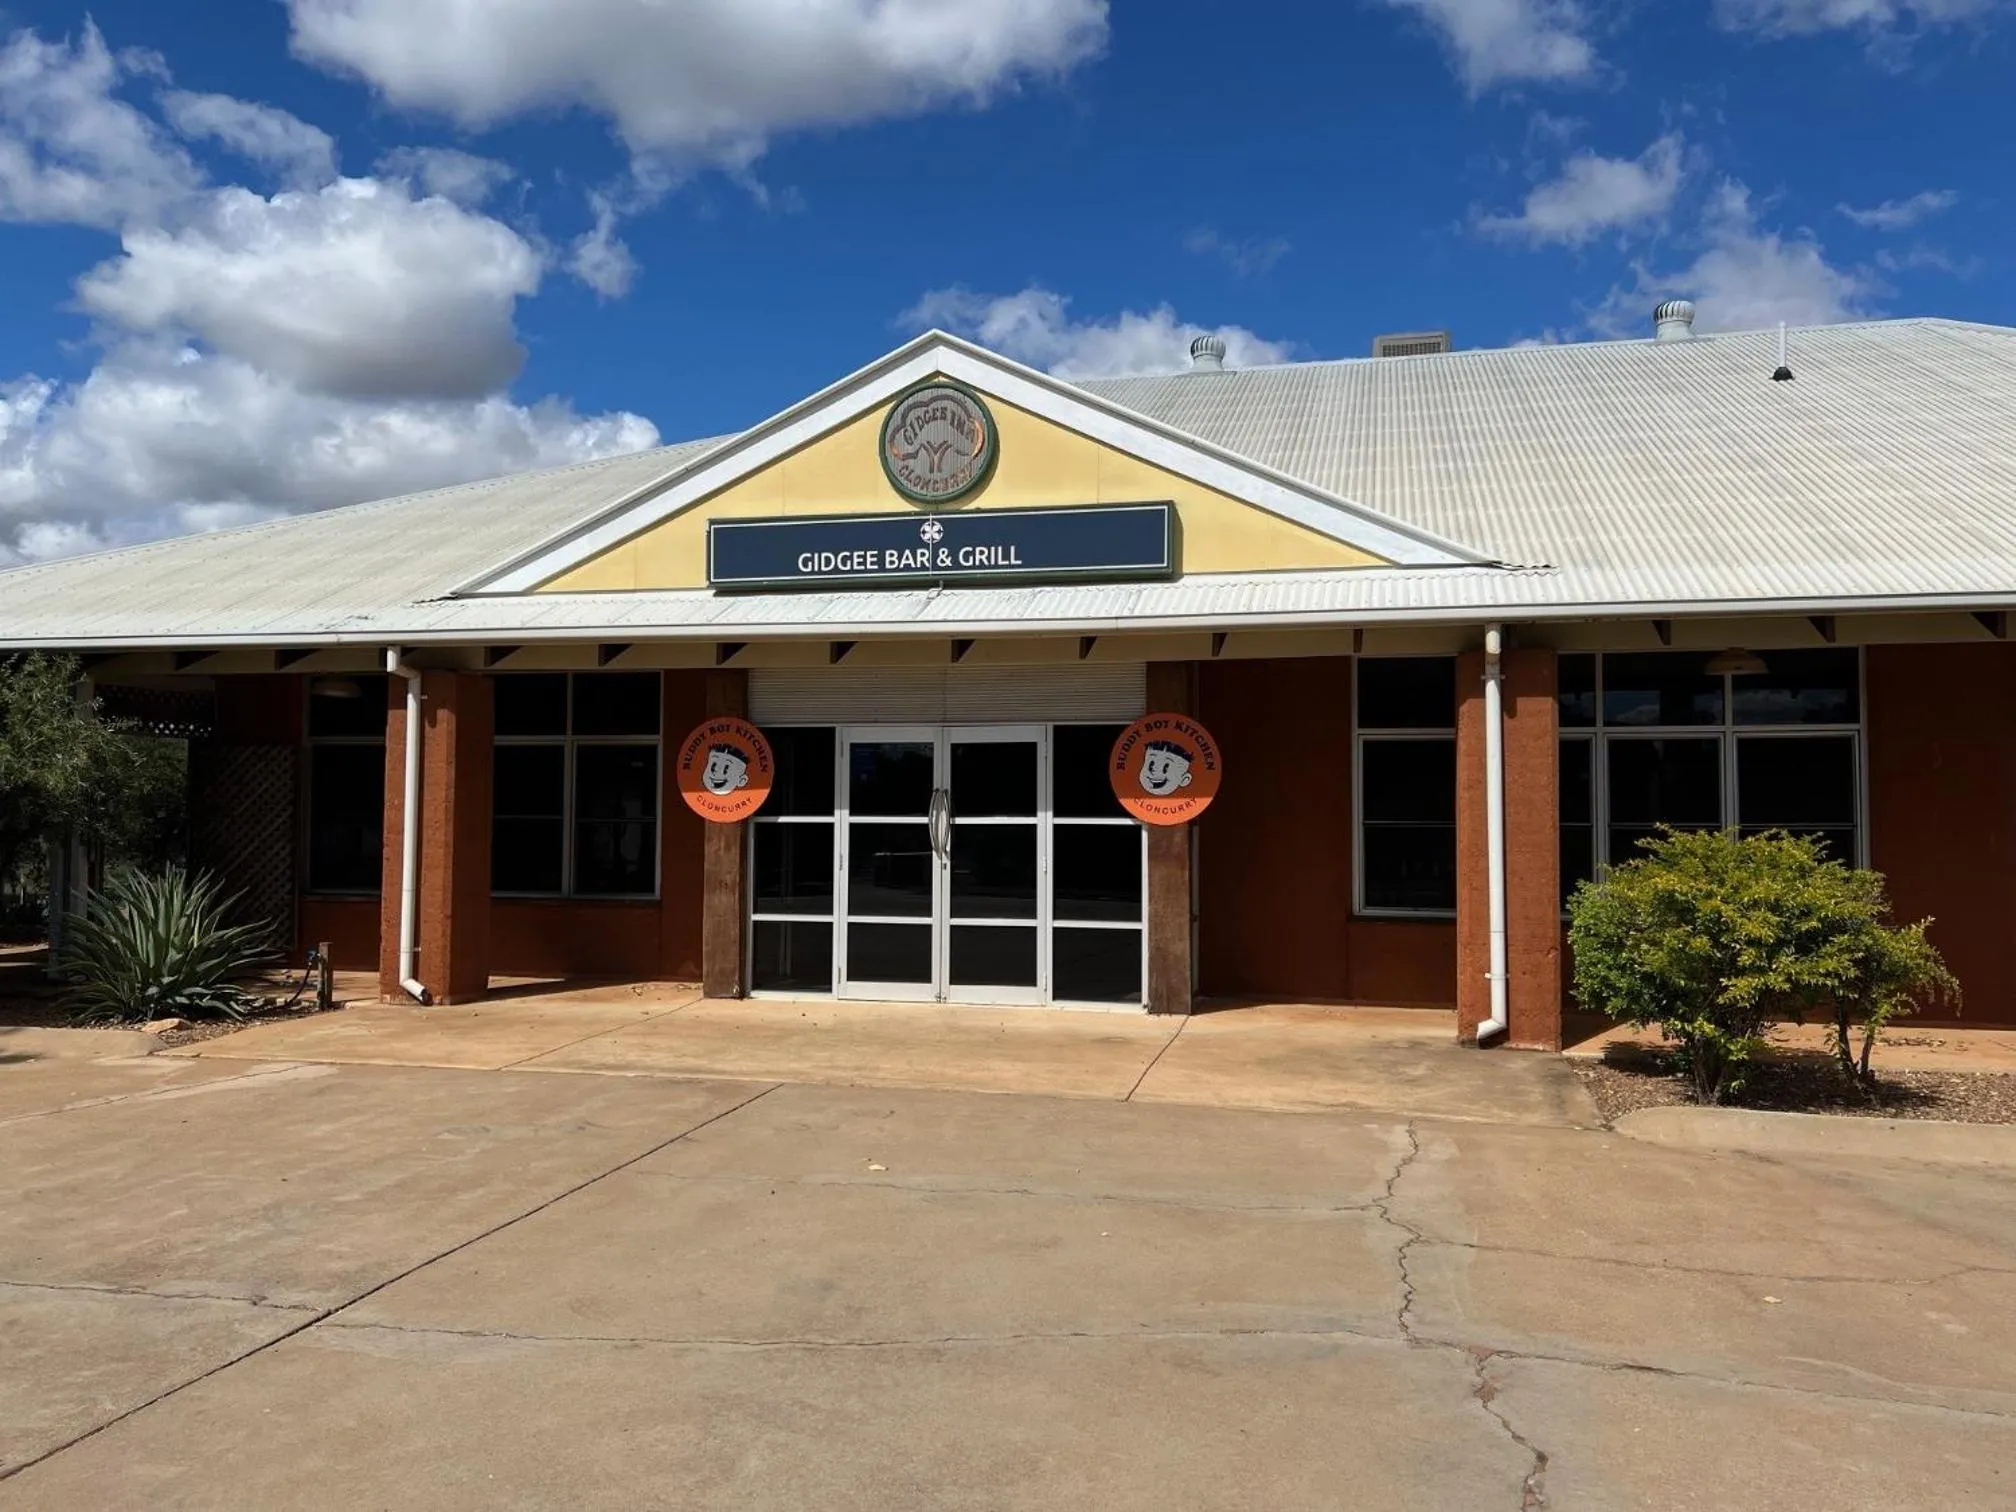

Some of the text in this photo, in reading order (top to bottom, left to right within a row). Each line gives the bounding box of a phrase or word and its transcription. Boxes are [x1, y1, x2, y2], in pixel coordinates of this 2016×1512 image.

[798, 545, 1022, 572] GIDGEE BAR & GRILL
[682, 732, 706, 770] BUDDY
[735, 725, 769, 773] KITCHEN
[1116, 728, 1142, 771] BUDDY
[1174, 719, 1216, 771] KITCHEN
[696, 795, 752, 813] CLONCURRY
[1133, 796, 1198, 815] CLONCURRY
